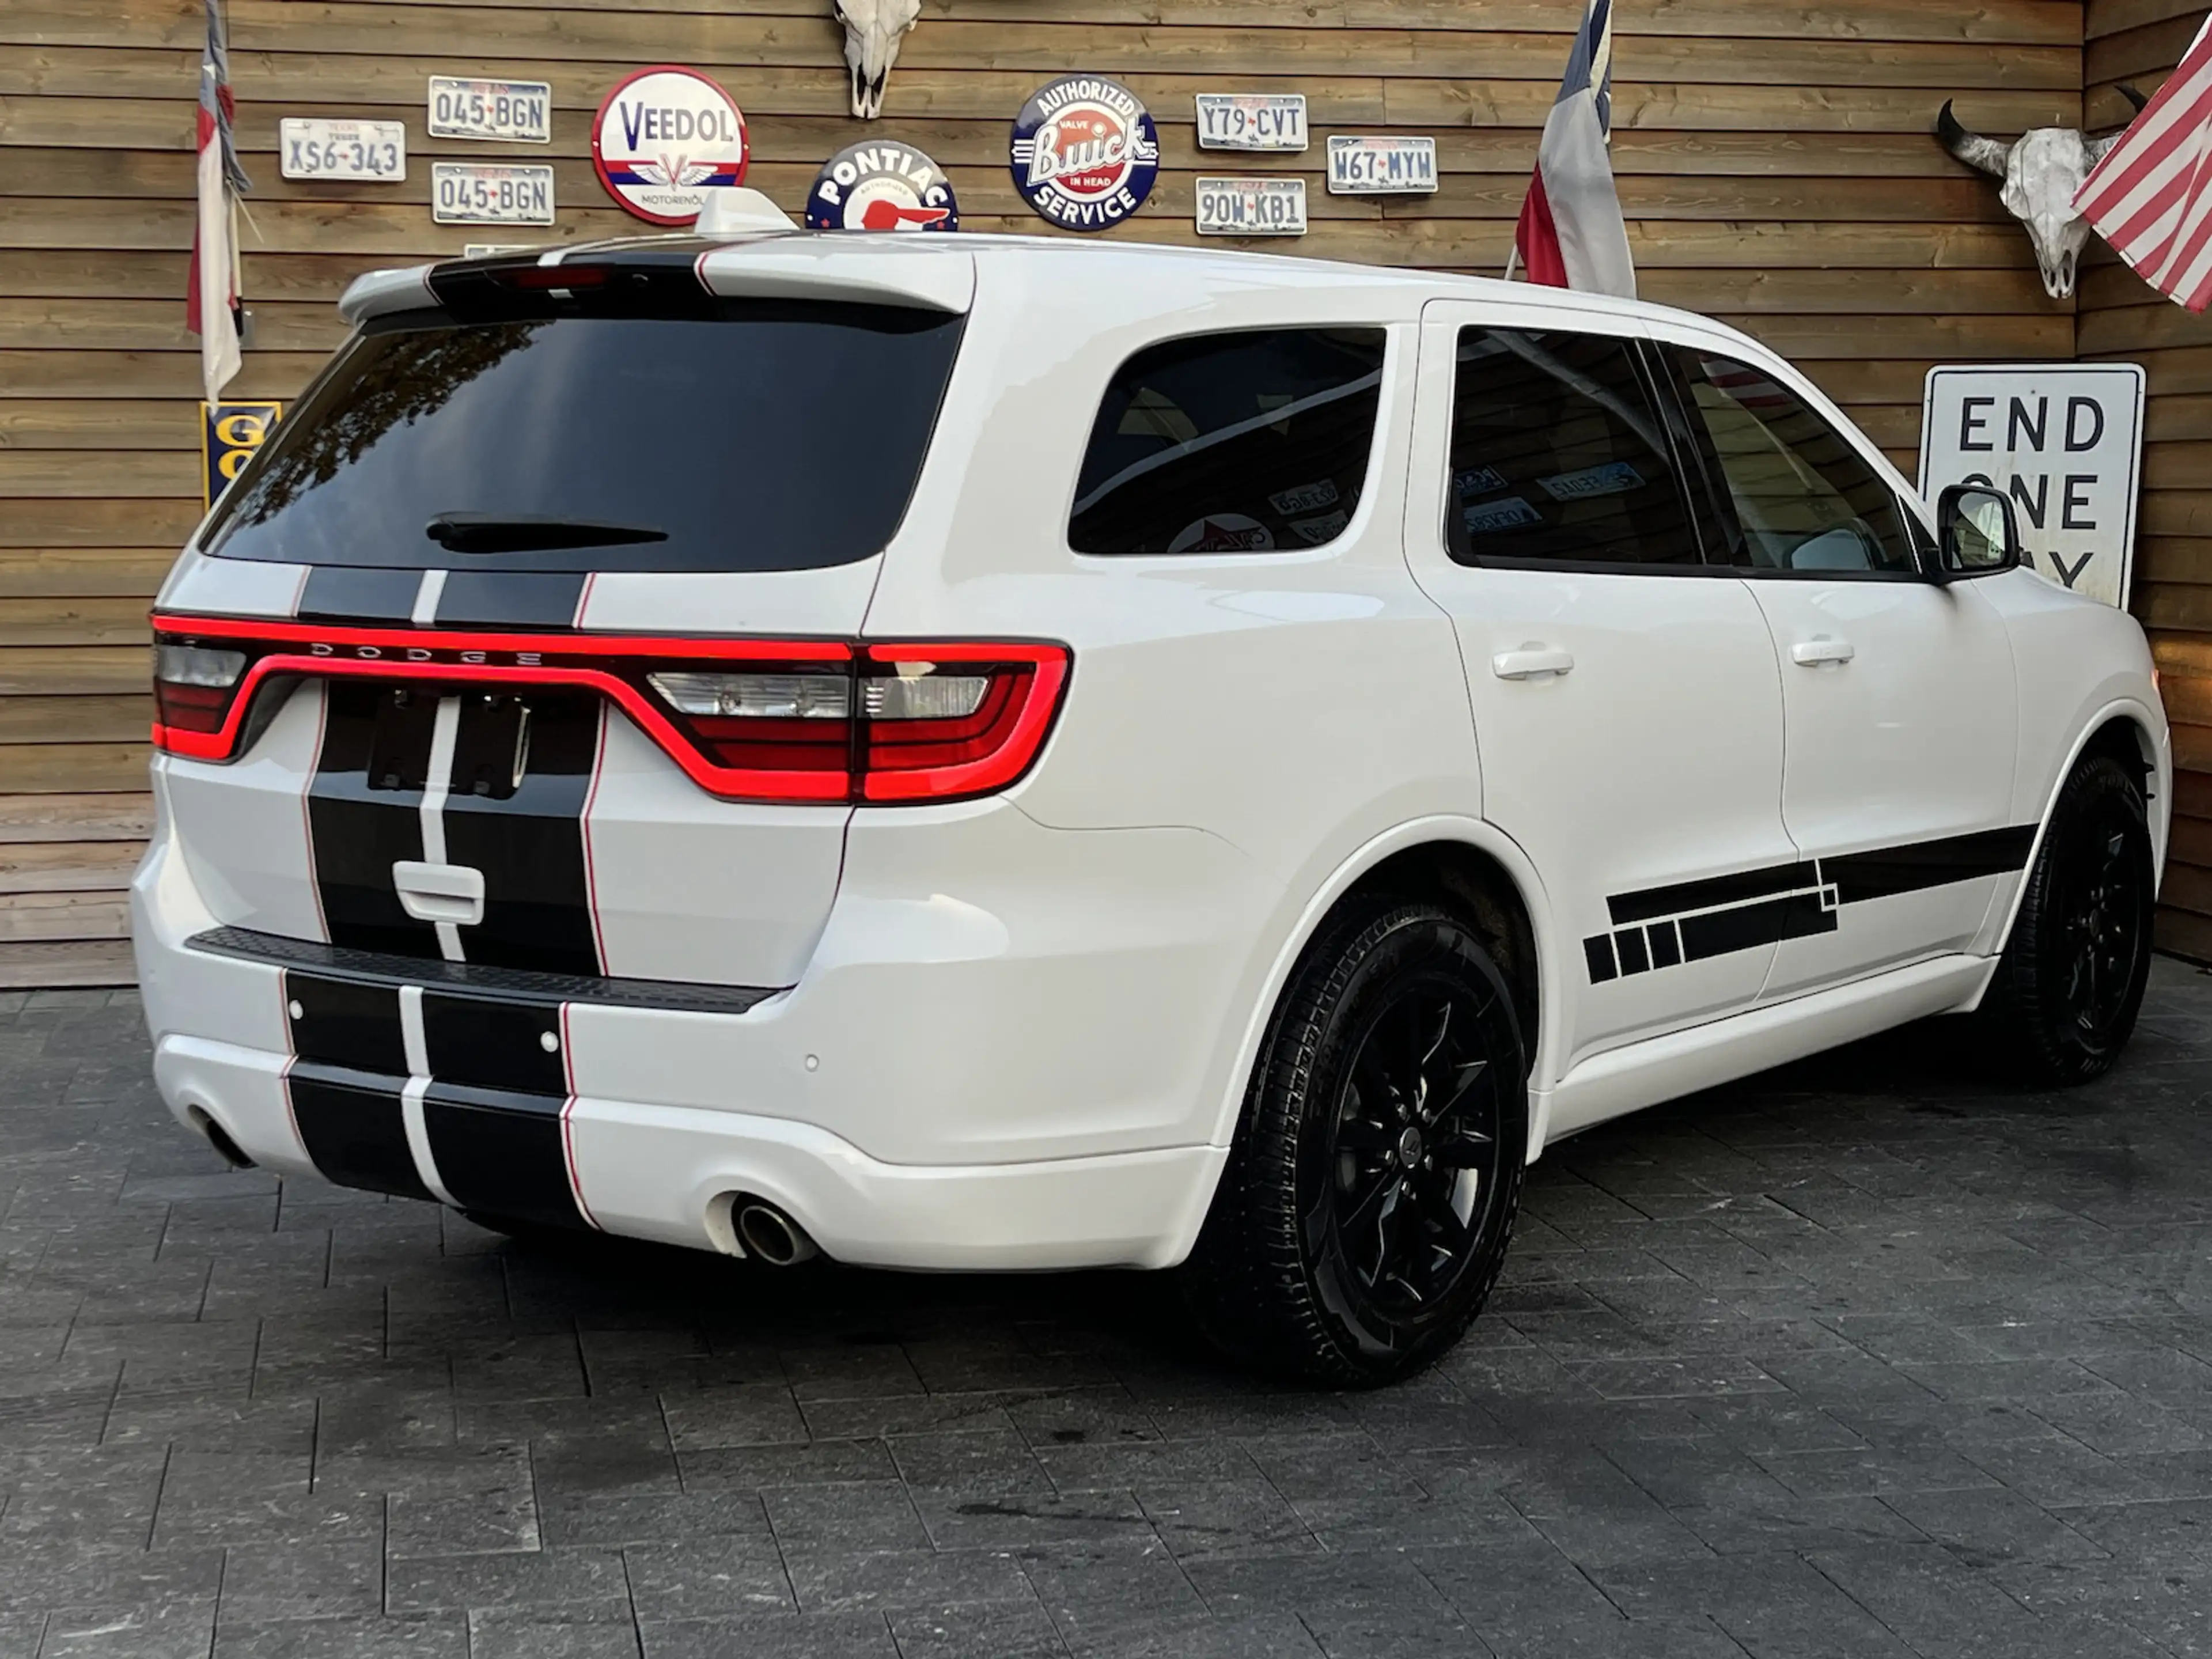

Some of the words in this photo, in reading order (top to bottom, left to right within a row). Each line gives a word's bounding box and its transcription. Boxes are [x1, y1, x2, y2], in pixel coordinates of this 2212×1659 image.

[1037, 80, 1134, 116] AUTHORIZED
[619, 102, 733, 151] VEEDOL
[1060, 120, 1089, 129] VALVE
[1027, 113, 1149, 186] Buick
[818, 148, 948, 206] PONTIAC
[1070, 177, 1081, 186] IN
[1084, 177, 1111, 186] HEAD
[1033, 185, 1136, 225] SERVICE
[1960, 396, 2104, 452] END
[1961, 473, 2098, 529] NE
[310, 642, 541, 666] DODGE
